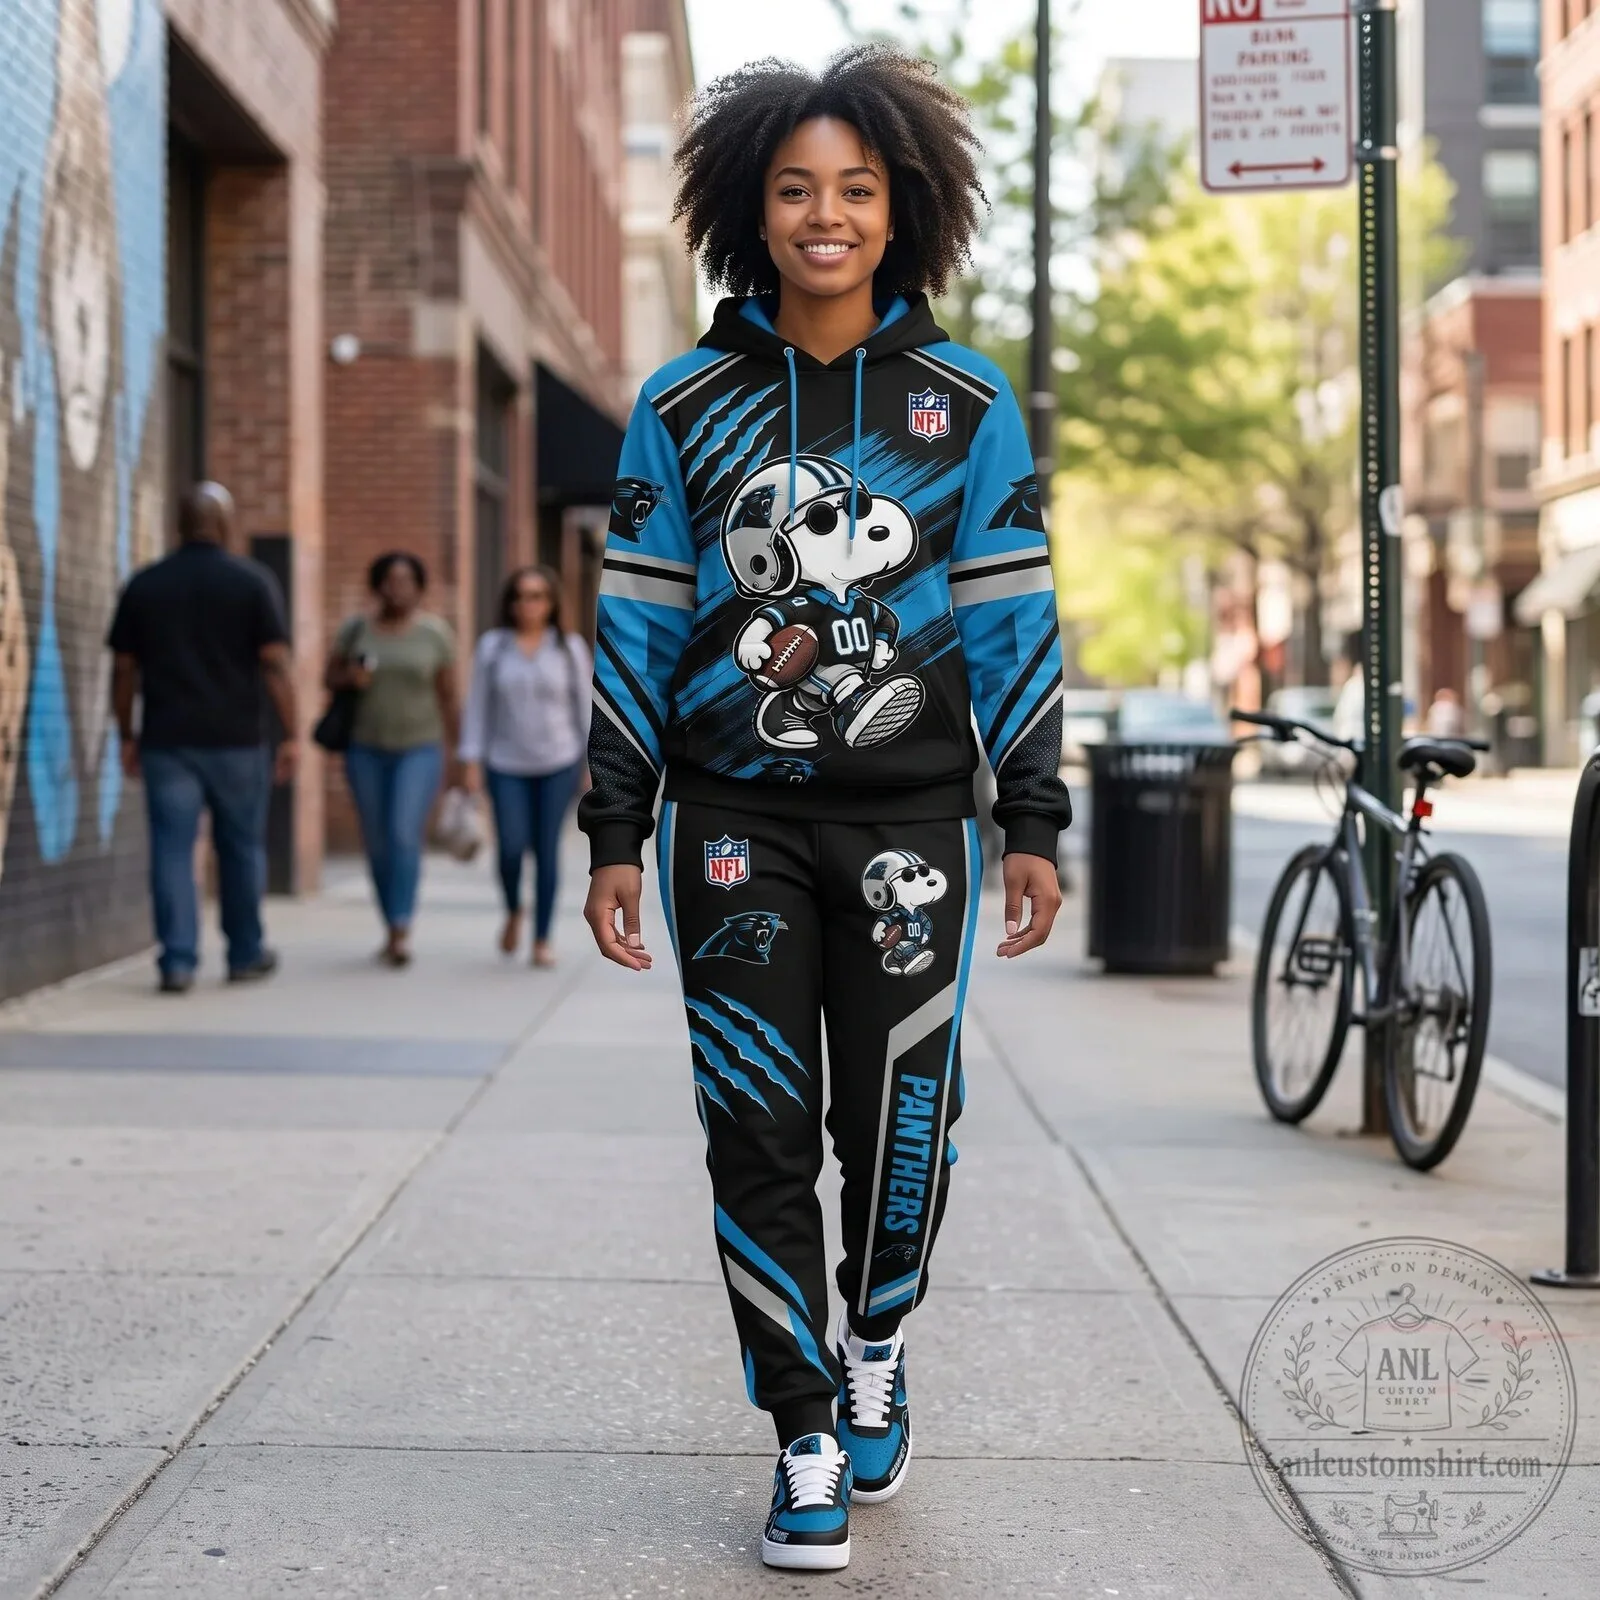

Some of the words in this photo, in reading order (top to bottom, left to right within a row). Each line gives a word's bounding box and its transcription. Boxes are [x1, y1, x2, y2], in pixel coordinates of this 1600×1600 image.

[913, 411, 946, 434] NFL
[831, 617, 870, 655] 00
[710, 859, 745, 883] NFL
[907, 922, 921, 937] 00
[884, 1074, 937, 1235] PANTHERS
